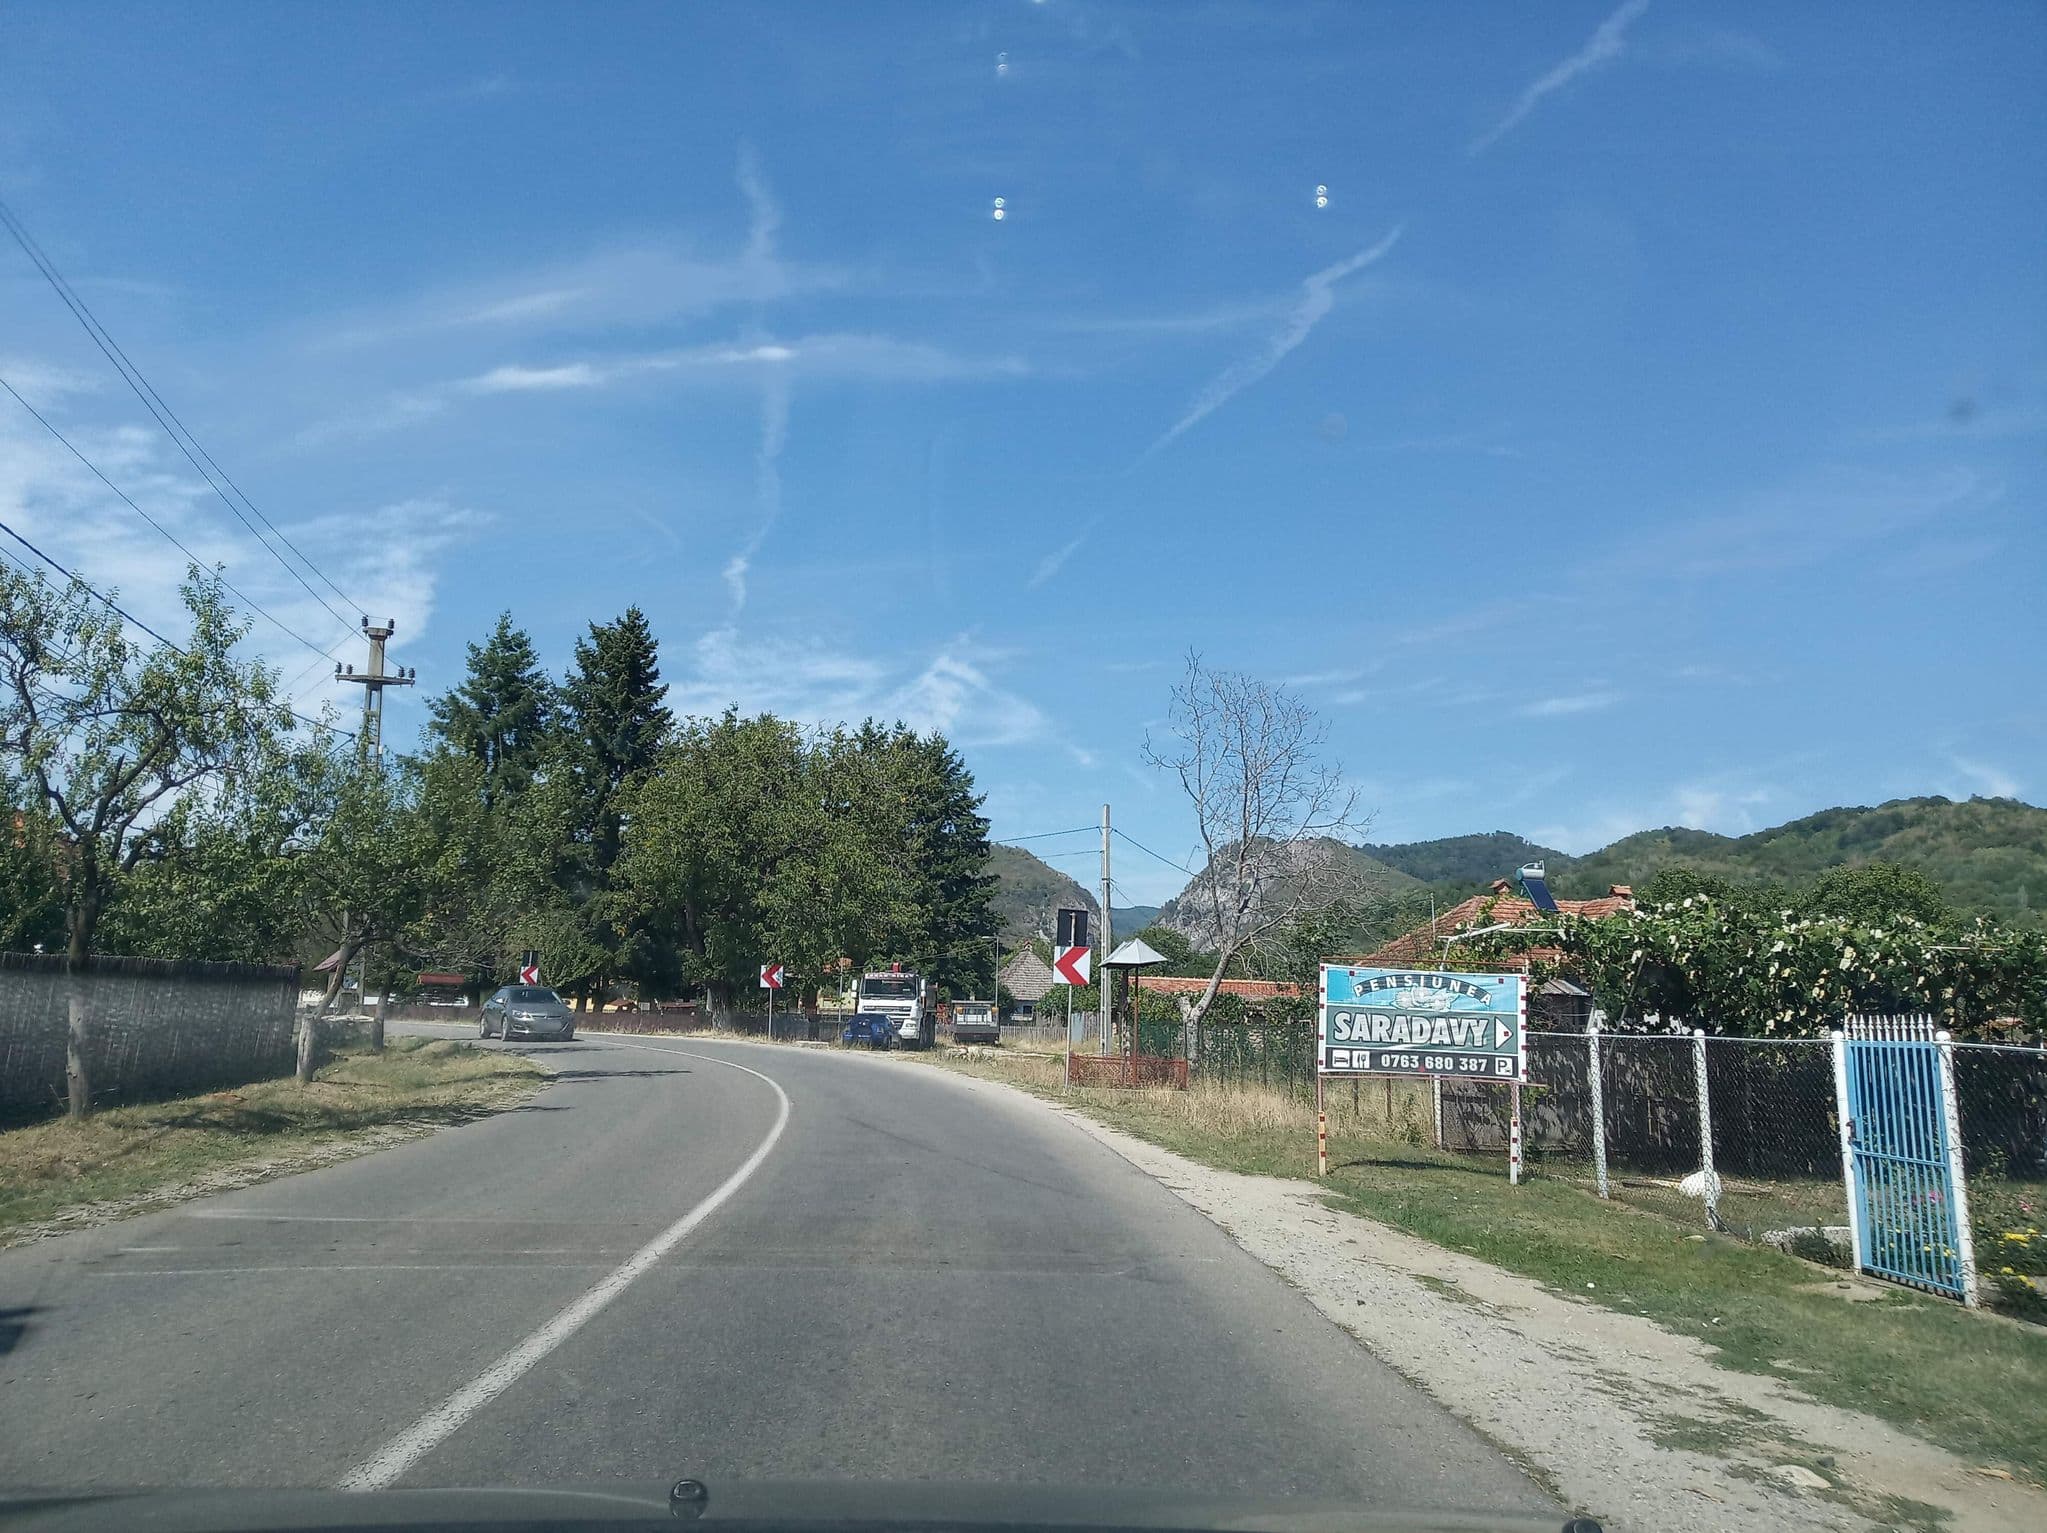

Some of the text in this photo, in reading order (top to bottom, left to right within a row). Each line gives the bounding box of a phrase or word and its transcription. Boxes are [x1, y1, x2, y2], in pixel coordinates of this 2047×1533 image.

[1354, 975, 1491, 1005] PENSIUNEA
[1333, 1011, 1489, 1047] SARADAVY
[1381, 1053, 1487, 1072] 0763 680 387
